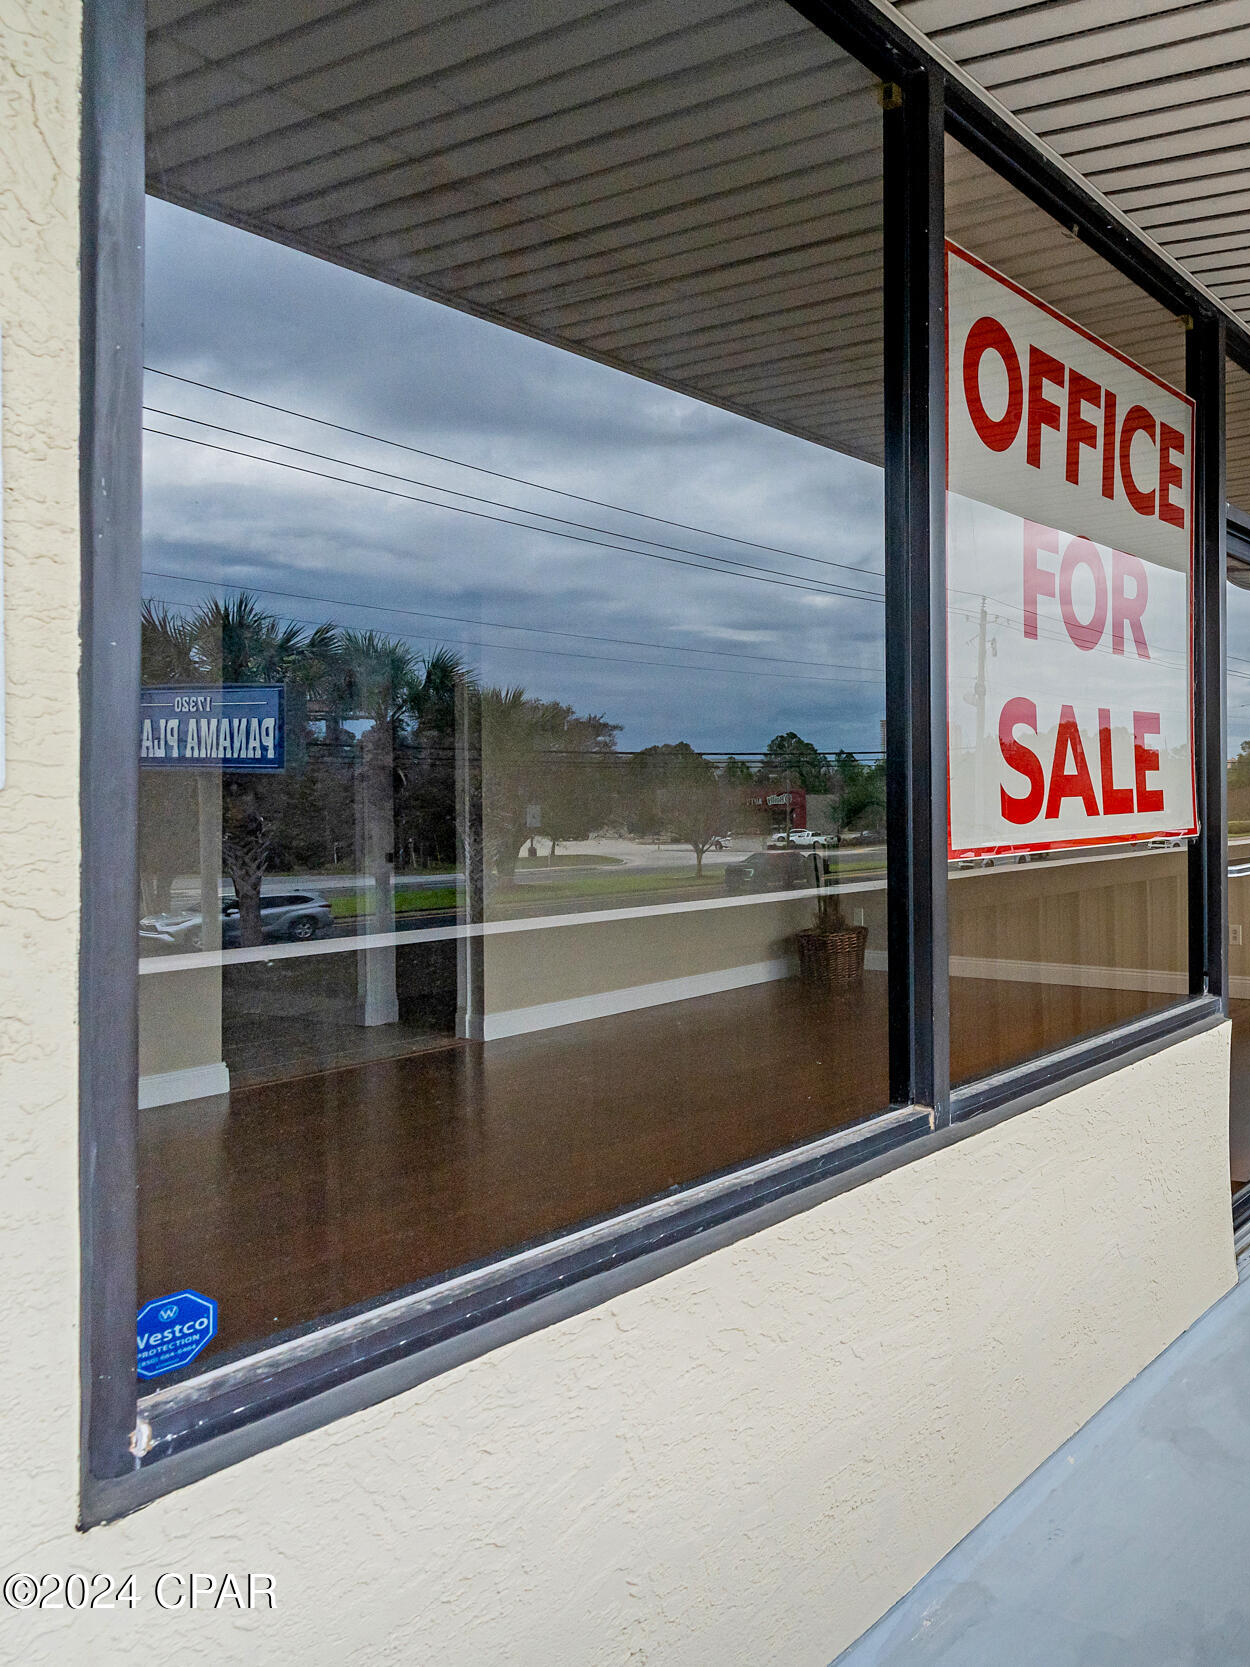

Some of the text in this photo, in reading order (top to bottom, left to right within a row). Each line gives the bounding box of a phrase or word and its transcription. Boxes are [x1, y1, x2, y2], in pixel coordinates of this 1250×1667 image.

[963, 316, 1185, 529] OFFICE
[1023, 519, 1150, 660] FOR
[998, 697, 1165, 825] SALE
